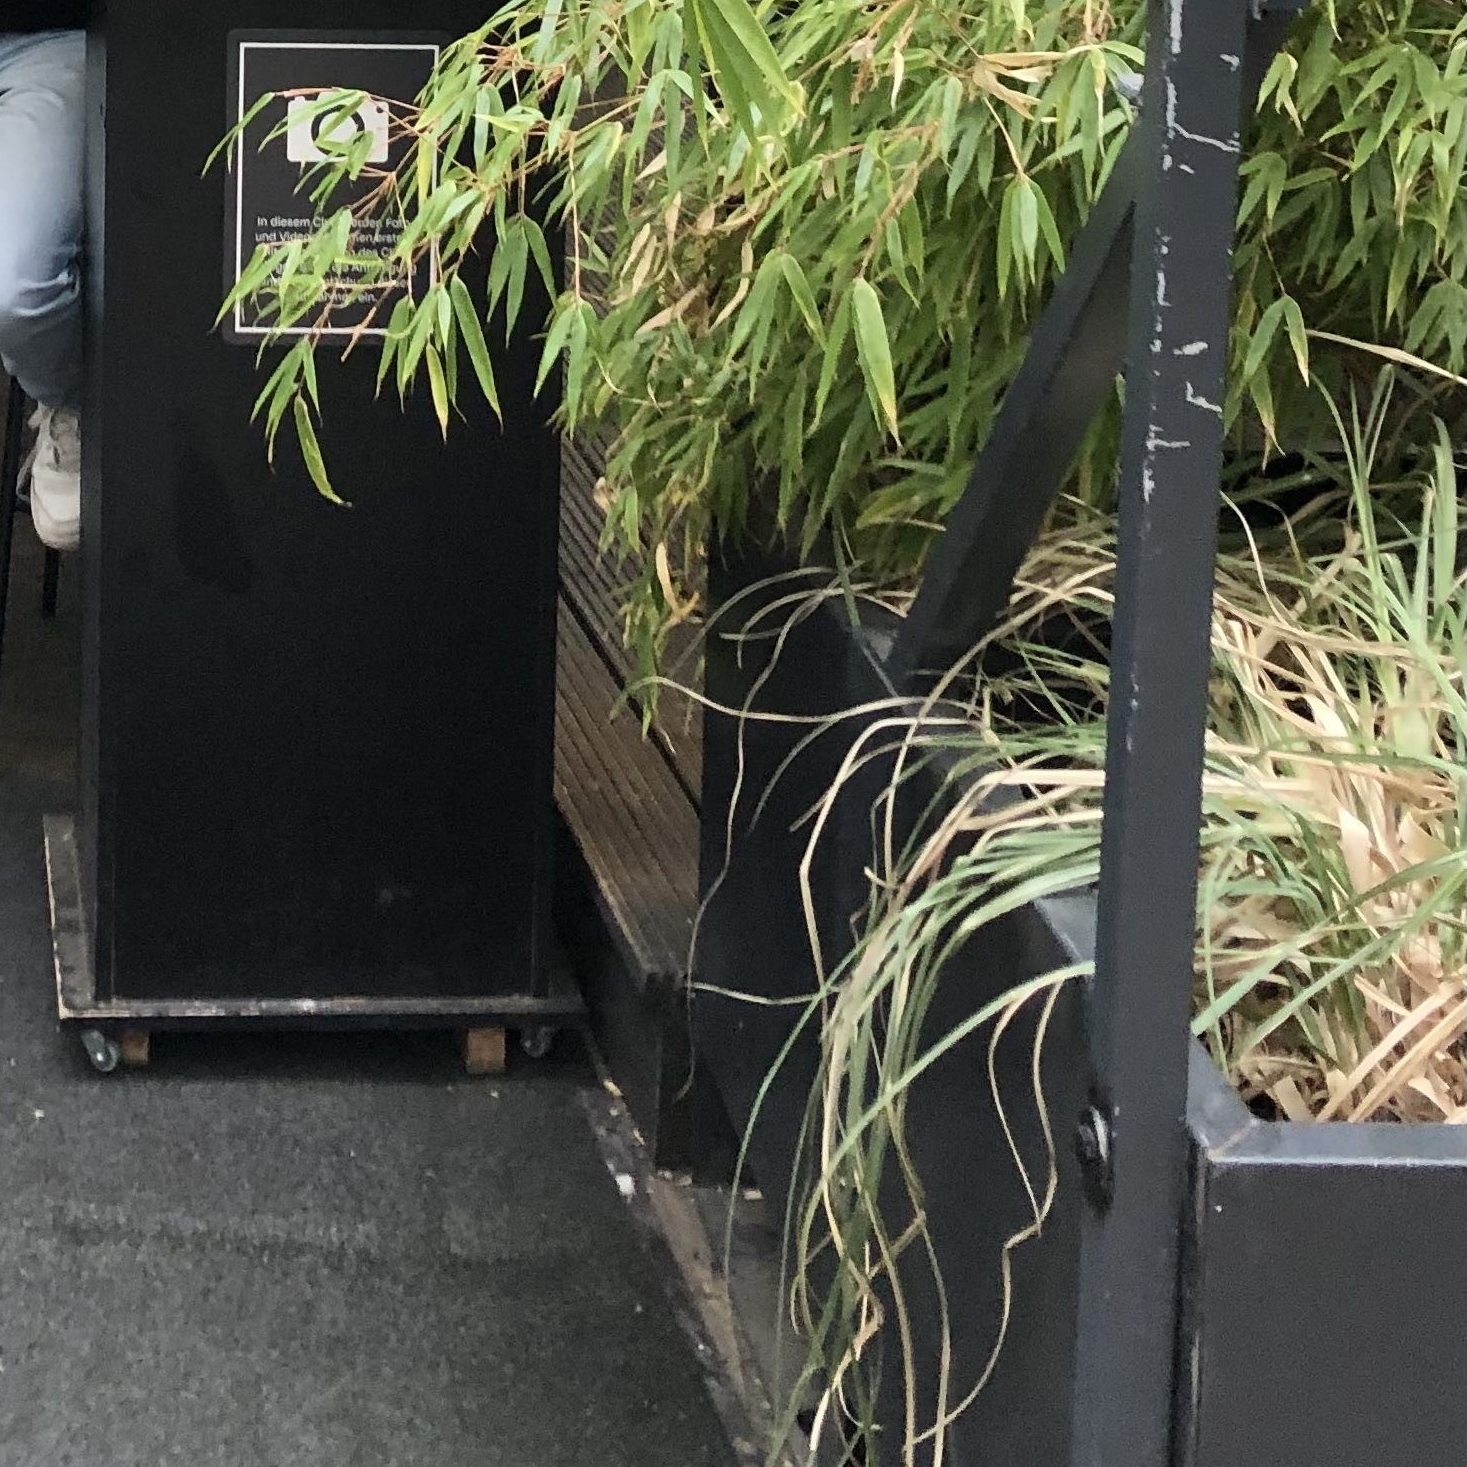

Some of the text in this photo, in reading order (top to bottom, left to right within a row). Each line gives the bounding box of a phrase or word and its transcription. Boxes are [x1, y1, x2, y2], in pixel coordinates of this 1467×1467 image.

[257, 216, 268, 226] In
[270, 215, 311, 228] diesem
[255, 231, 277, 243] und
